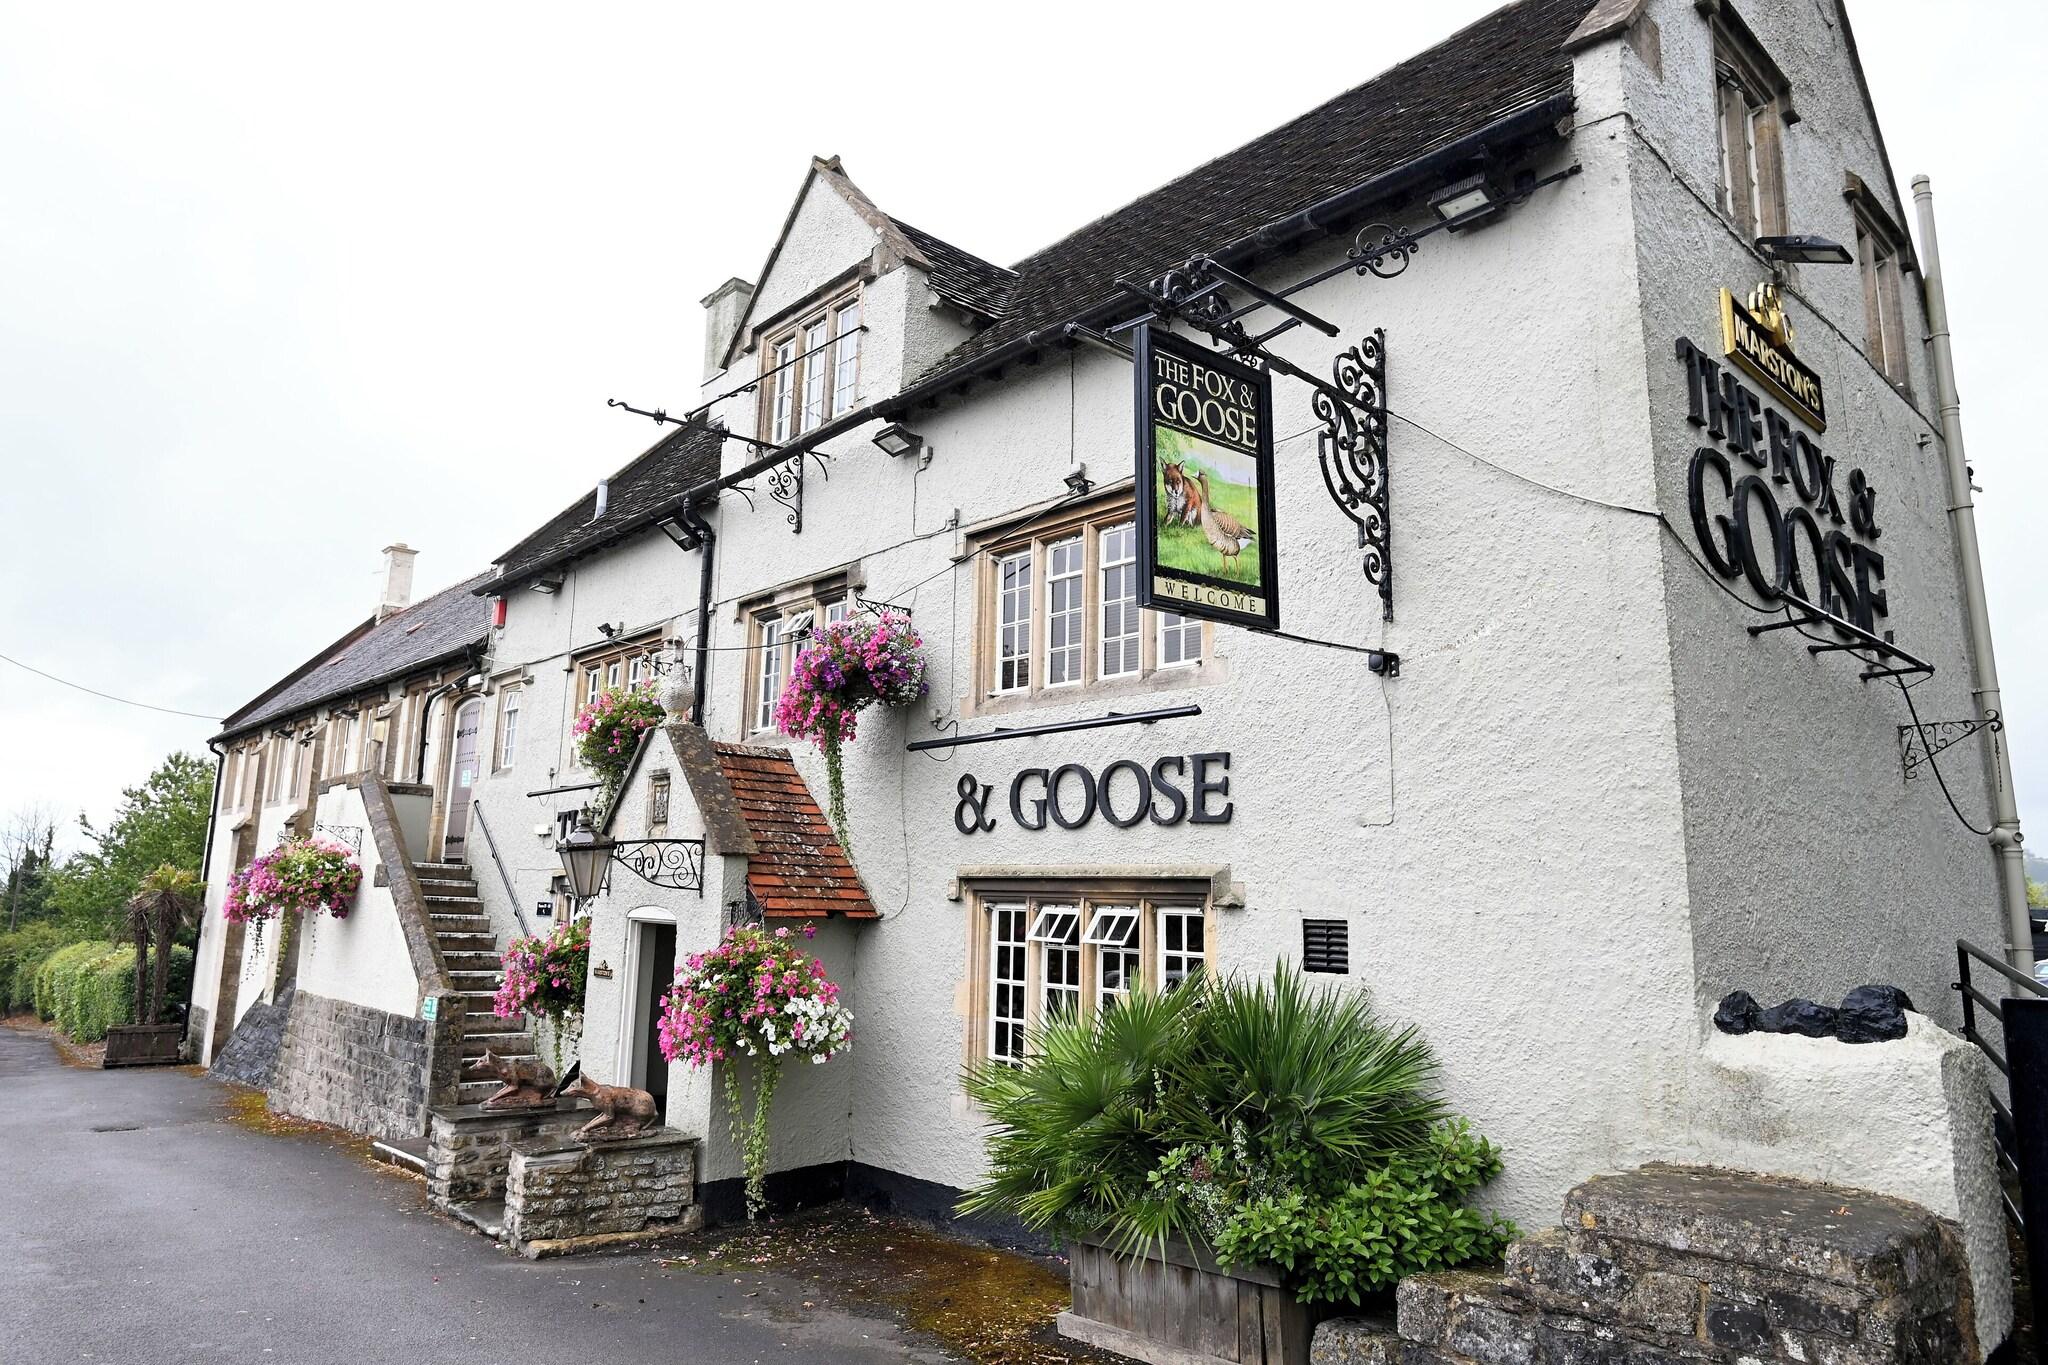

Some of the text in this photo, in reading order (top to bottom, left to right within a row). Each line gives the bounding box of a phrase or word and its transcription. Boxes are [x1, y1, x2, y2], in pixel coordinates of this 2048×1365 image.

[1154, 355, 1256, 410] THE FOX &
[1734, 312, 1820, 411] MARSTON'S
[1156, 383, 1258, 448] GOOSE
[1675, 336, 1882, 539] THE FOX &
[1688, 447, 1895, 658] GOOSE
[1165, 581, 1257, 613] WELCOME
[954, 751, 1234, 835] & GOOSE
